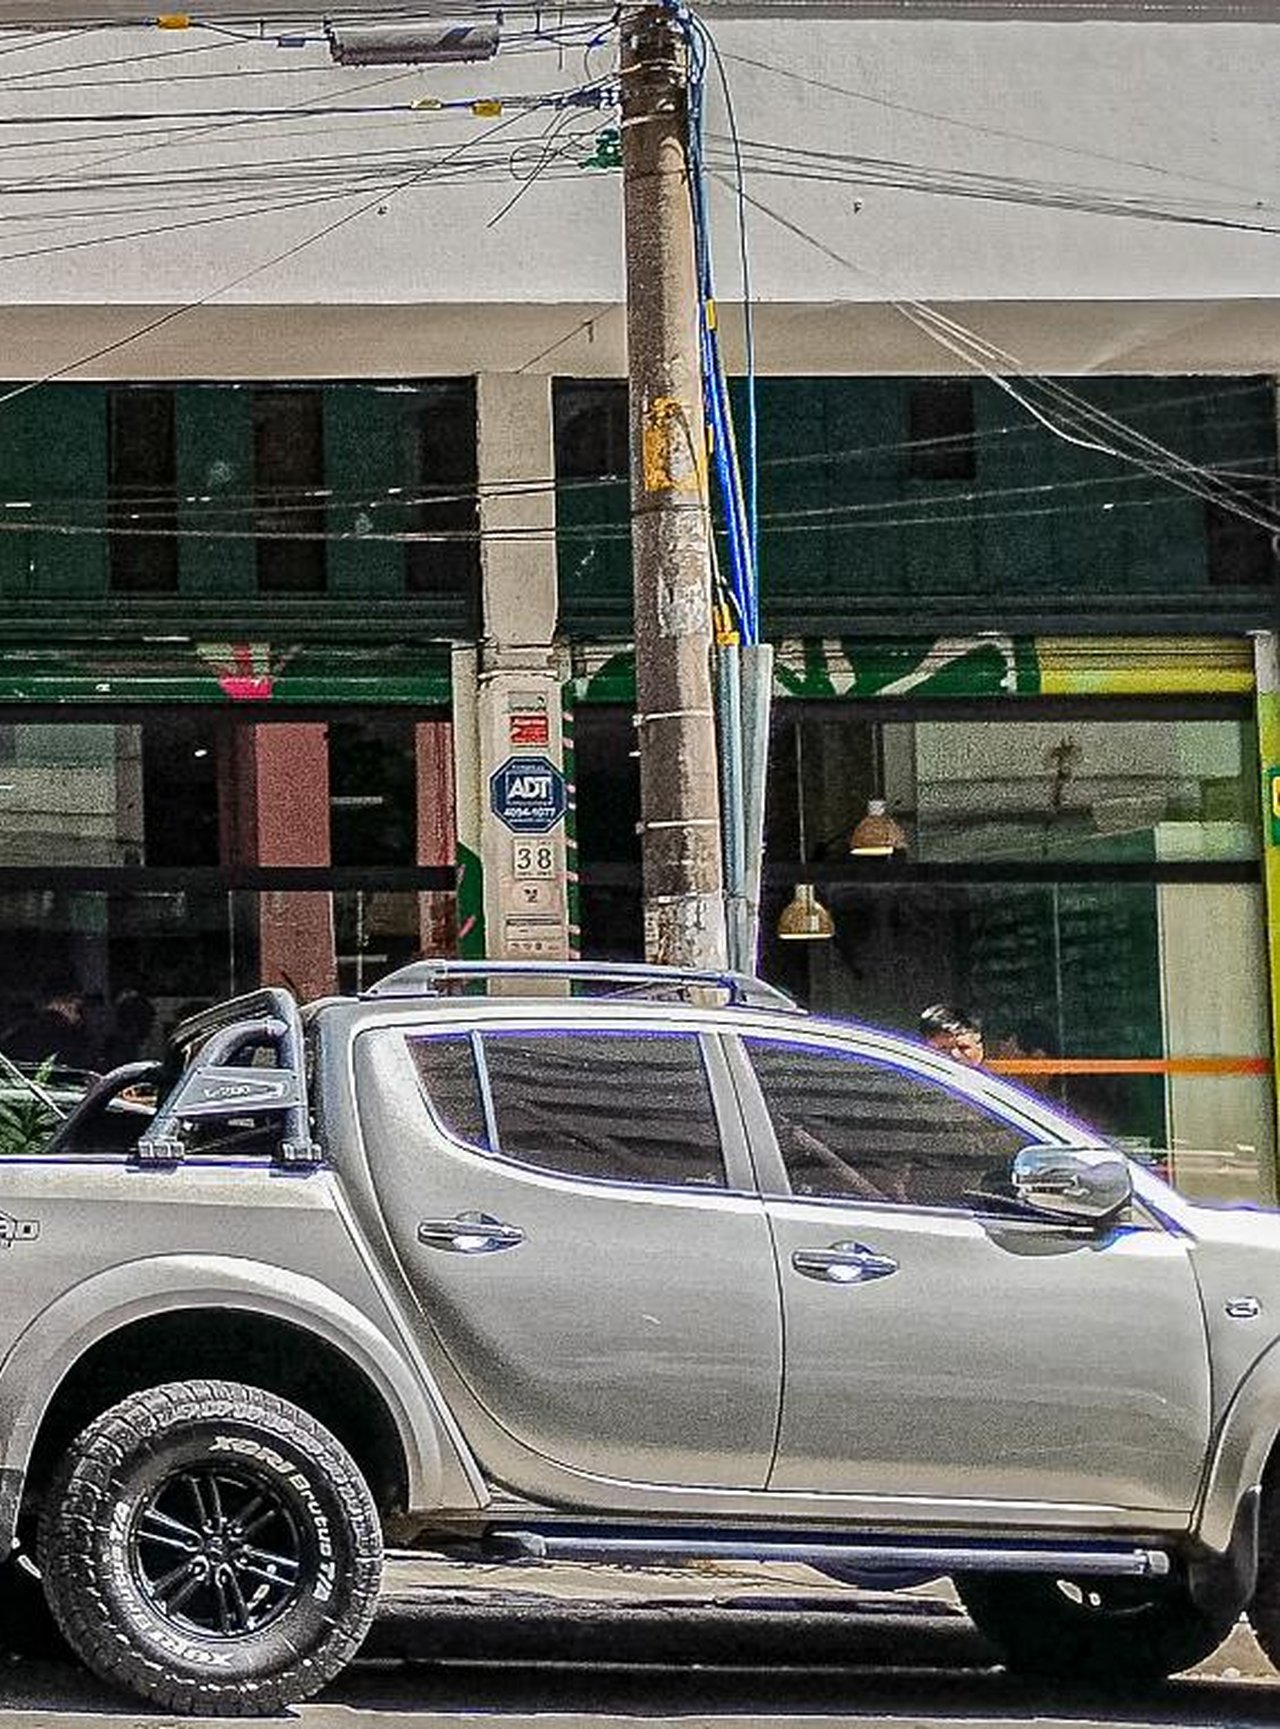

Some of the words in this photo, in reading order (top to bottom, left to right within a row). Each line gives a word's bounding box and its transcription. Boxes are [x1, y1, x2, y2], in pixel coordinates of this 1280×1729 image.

[508, 777, 551, 799] ADT
[517, 848, 552, 869] 38
[289, 1473, 333, 1557] Brutus
[312, 1561, 337, 1601] T/A
